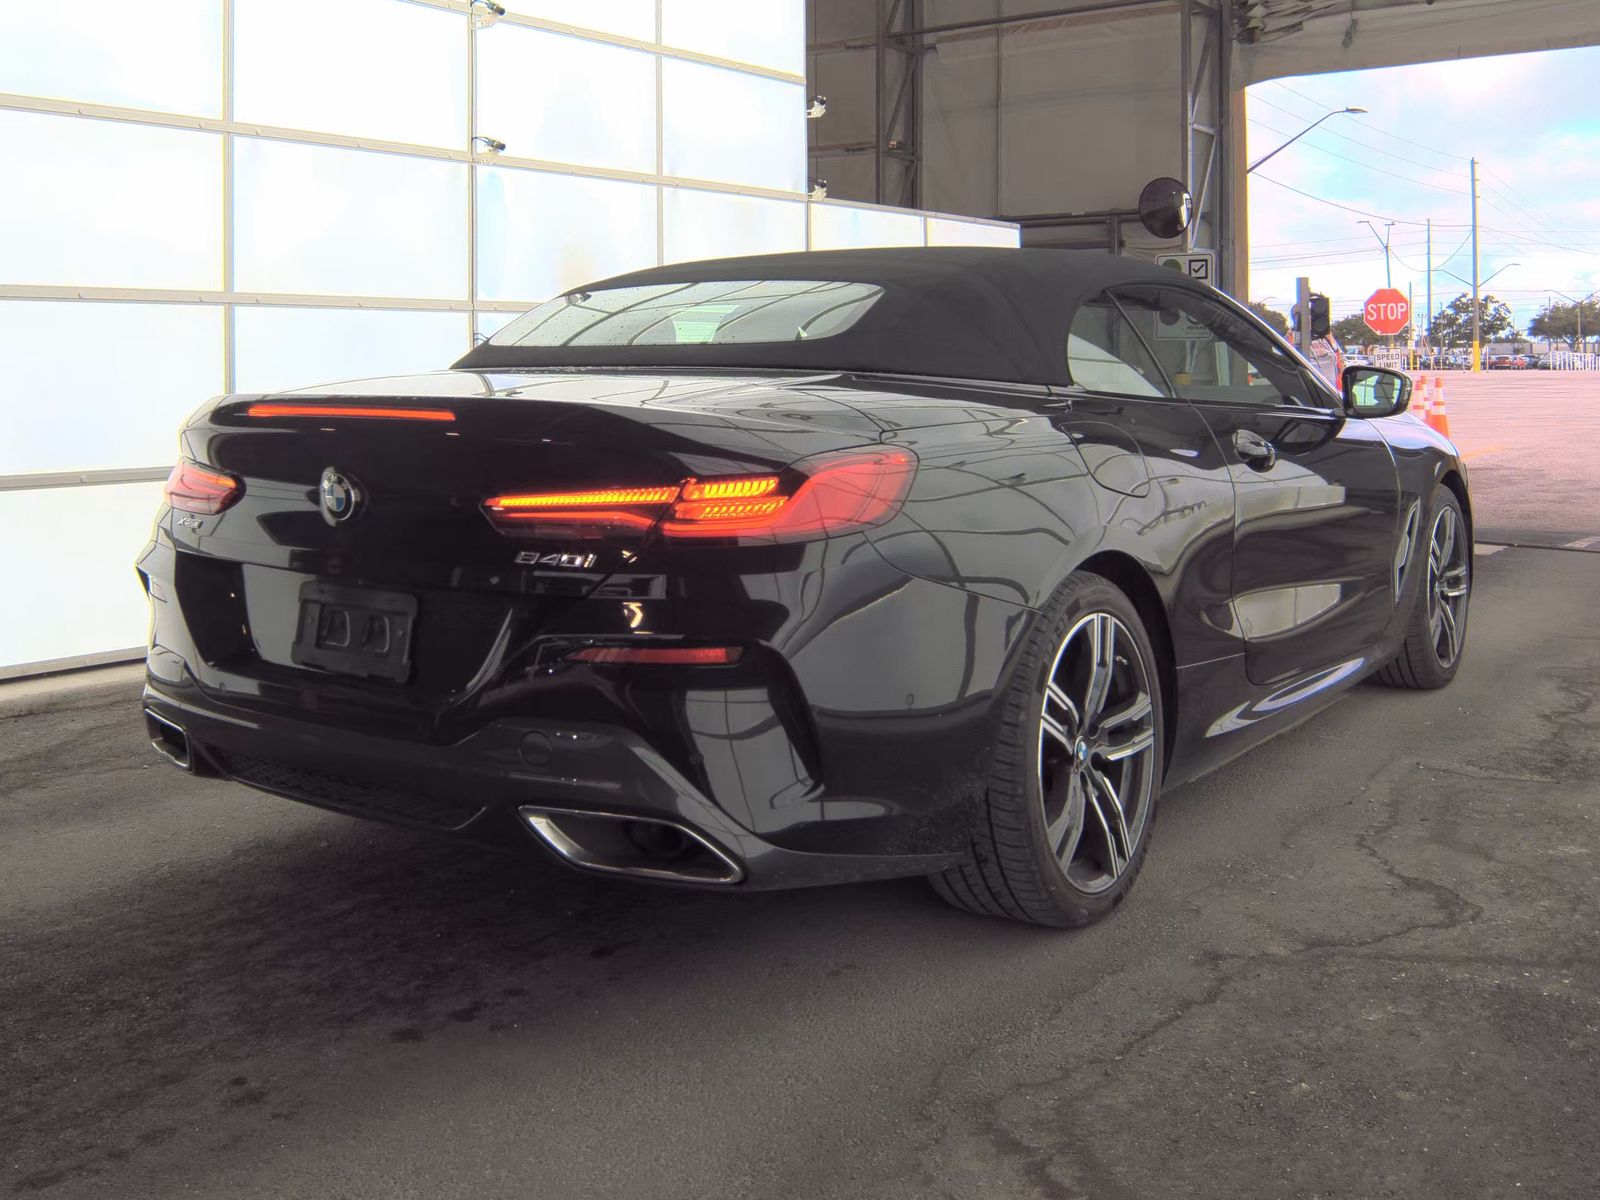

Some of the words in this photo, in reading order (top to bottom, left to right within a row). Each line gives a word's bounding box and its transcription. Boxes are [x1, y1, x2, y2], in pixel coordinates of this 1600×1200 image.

[1367, 302, 1407, 320] STOP
[1376, 353, 1400, 361] SPEED
[1380, 361, 1398, 369] LIMIT
[514, 551, 597, 568] 840i
